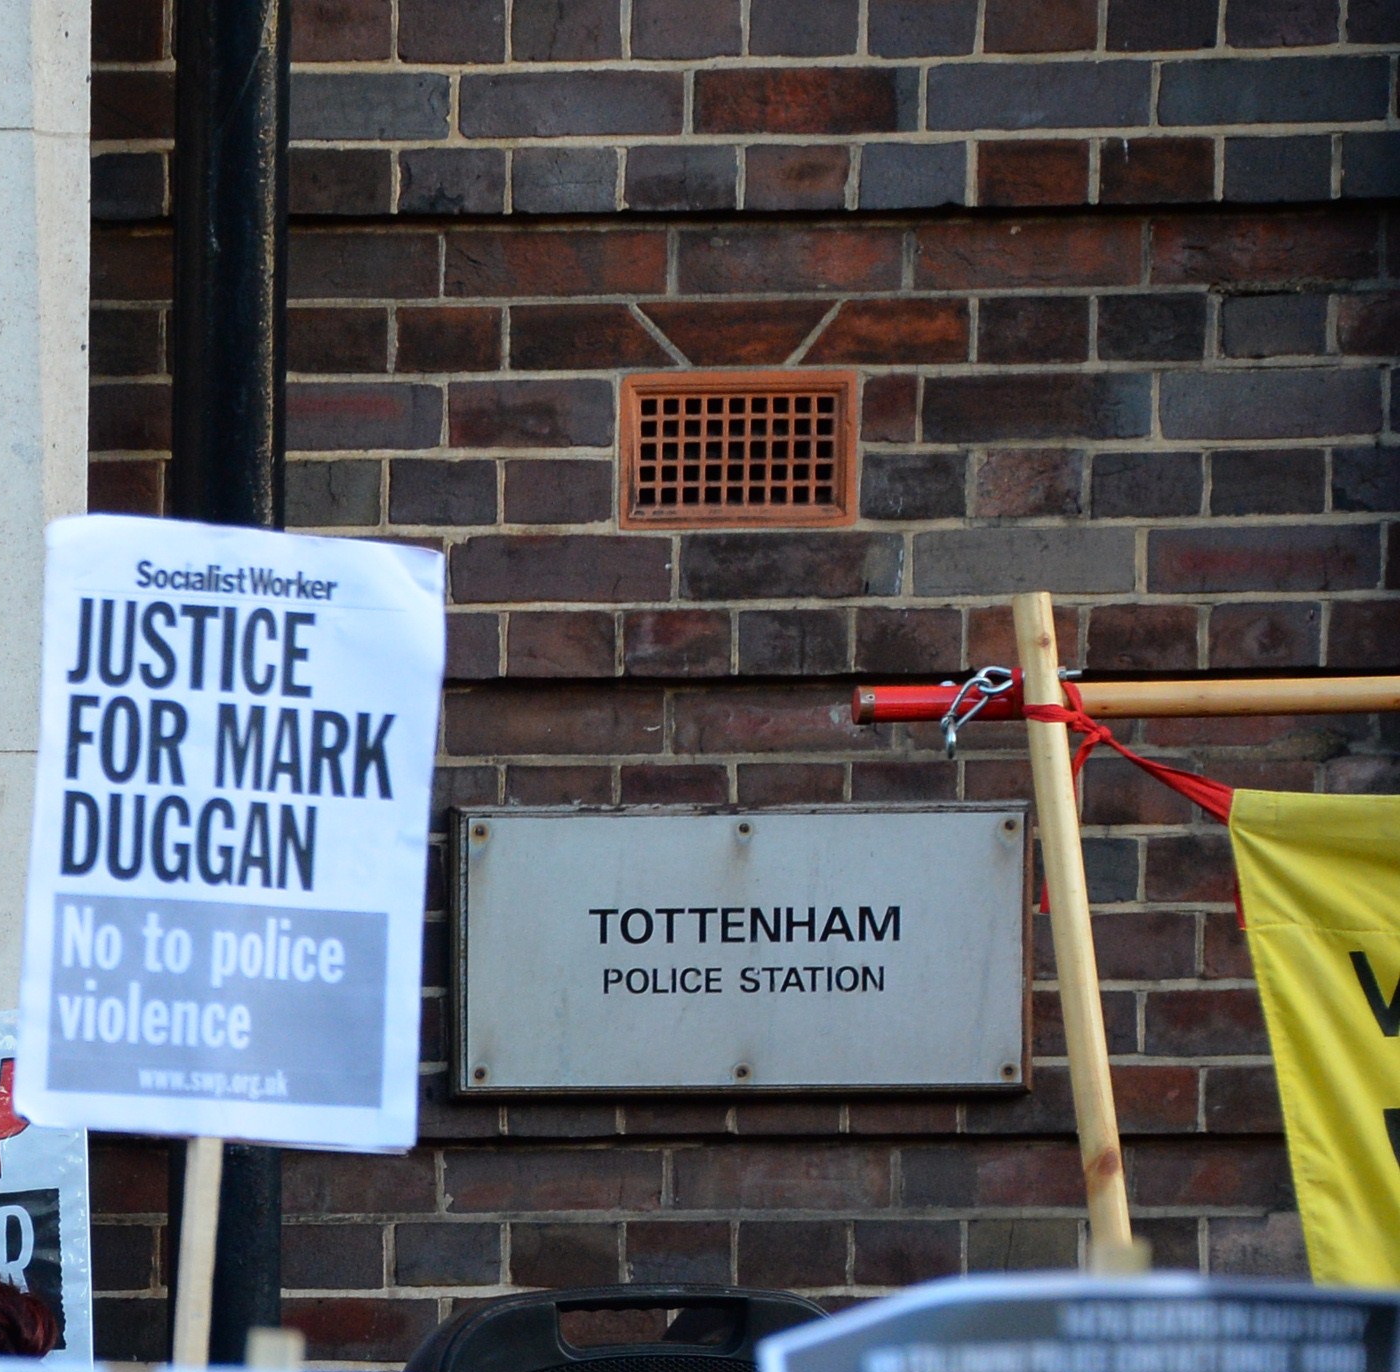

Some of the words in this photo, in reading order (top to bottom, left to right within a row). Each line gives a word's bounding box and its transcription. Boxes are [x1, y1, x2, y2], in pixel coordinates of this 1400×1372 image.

[136, 560, 245, 594] Socialist
[250, 567, 338, 600] Worker
[67, 598, 316, 698] JUSTICE
[65, 694, 188, 786] FOR
[215, 703, 396, 800] MARK
[60, 790, 318, 892] DUGGAN
[62, 904, 123, 970] No
[142, 911, 192, 974] to
[211, 917, 346, 988] police
[590, 905, 901, 944] TOTTENHAM
[58, 978, 251, 1050] violence
[603, 968, 722, 996] POLICE
[739, 965, 886, 994] STATION
